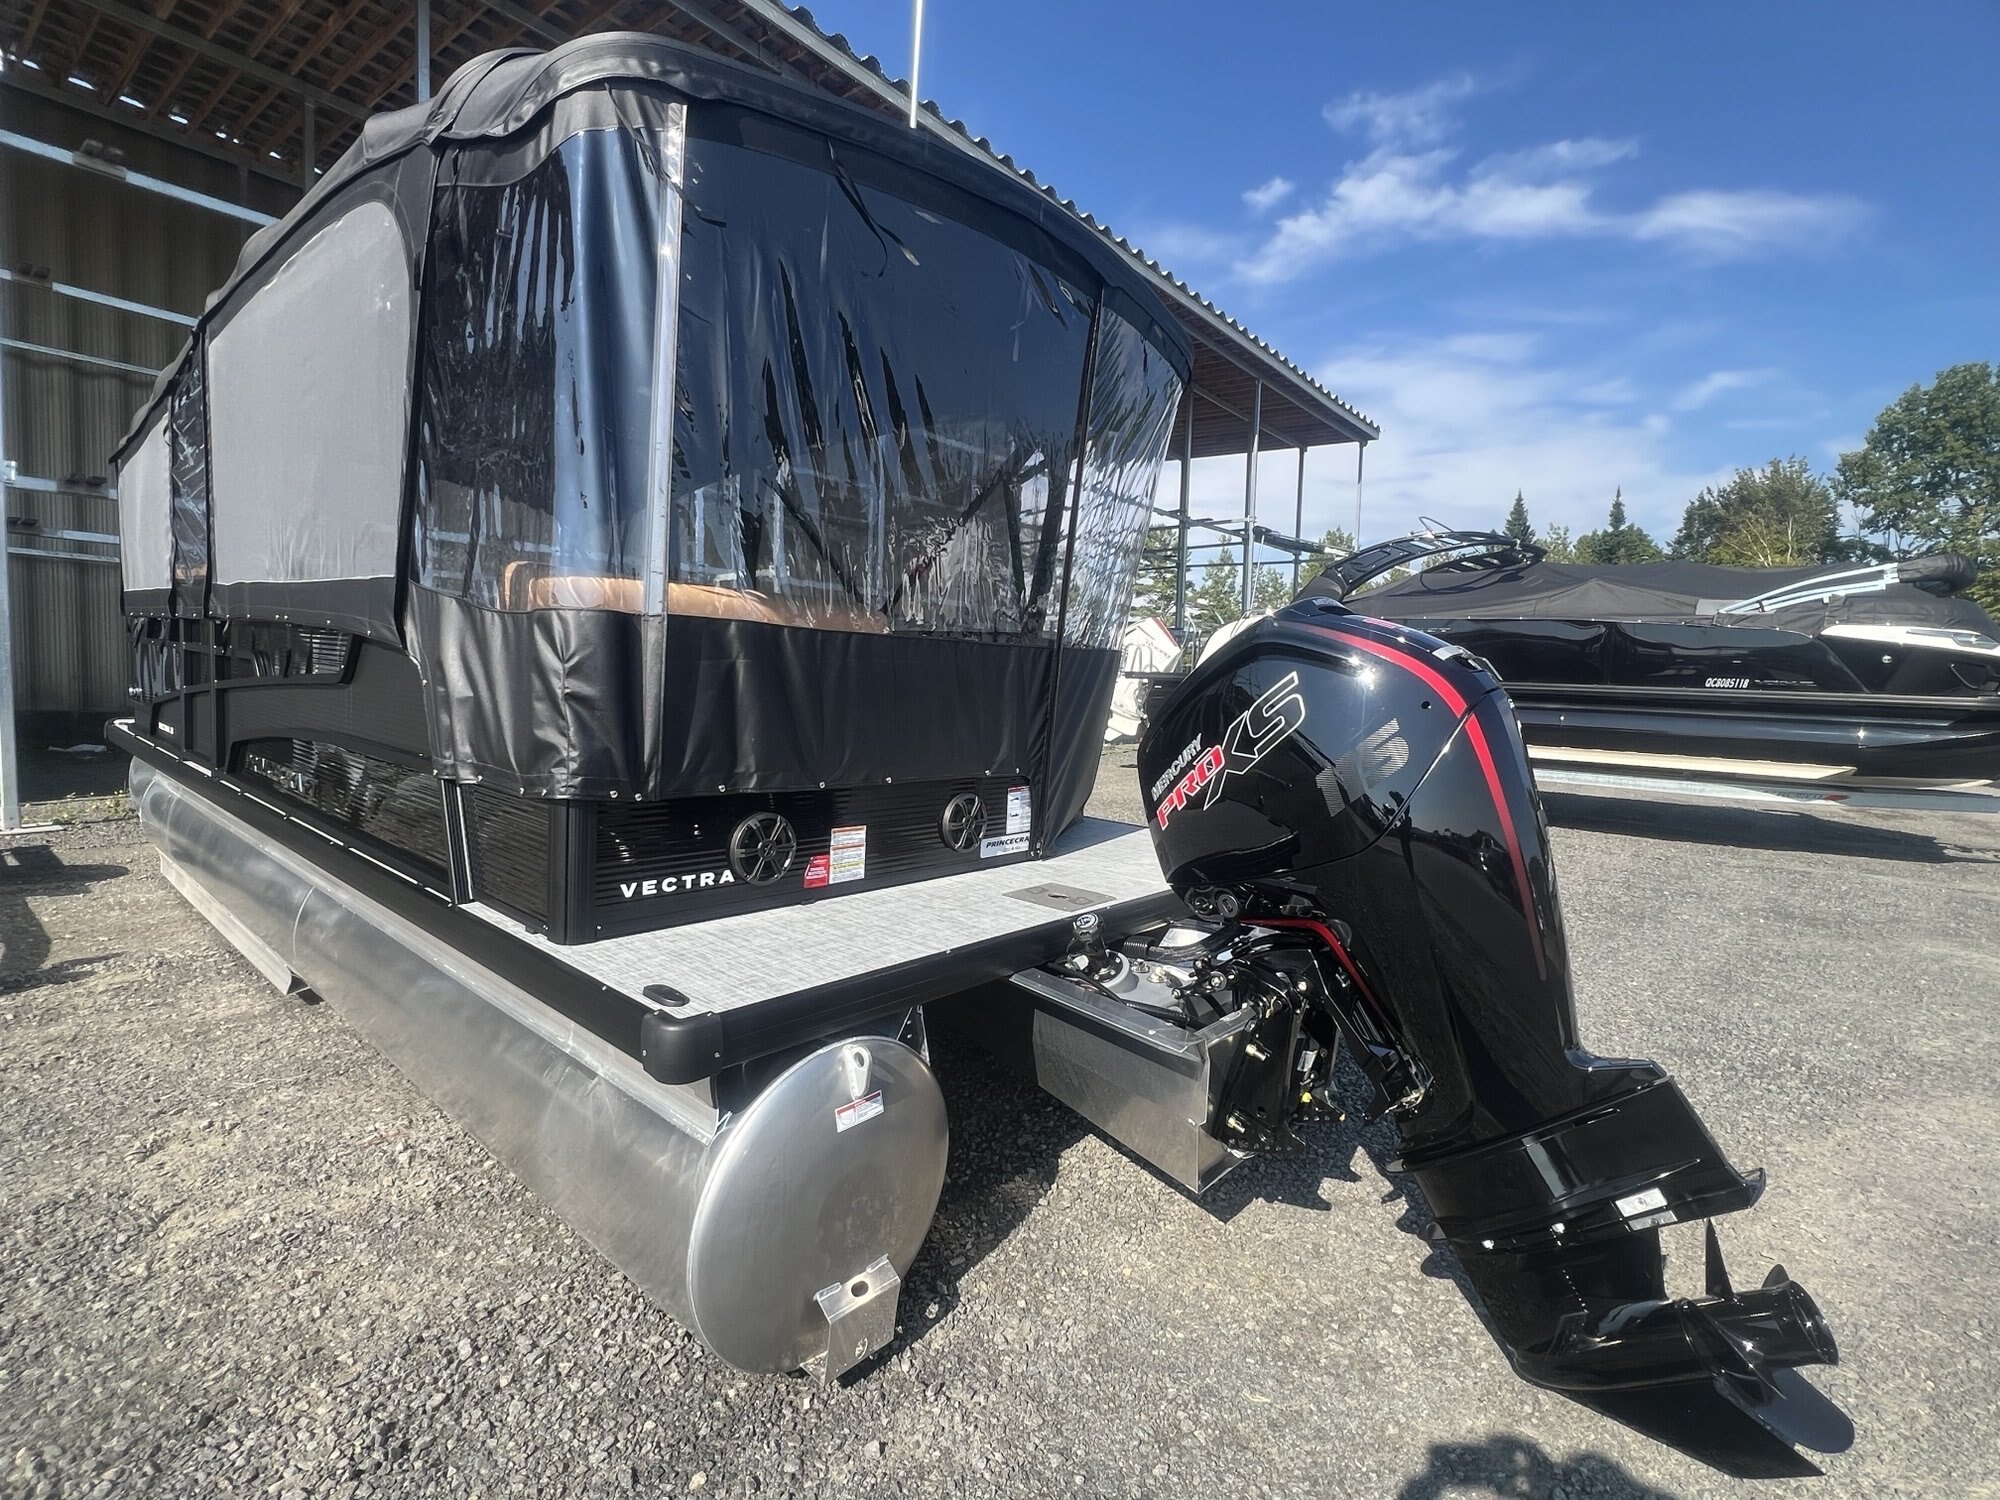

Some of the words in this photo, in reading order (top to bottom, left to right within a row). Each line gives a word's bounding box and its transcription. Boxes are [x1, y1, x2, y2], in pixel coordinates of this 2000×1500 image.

[1151, 733, 1202, 802] MERCURY
[1156, 744, 1226, 832] PRO
[1193, 670, 1307, 812] XS
[620, 869, 735, 898] VECTRA
